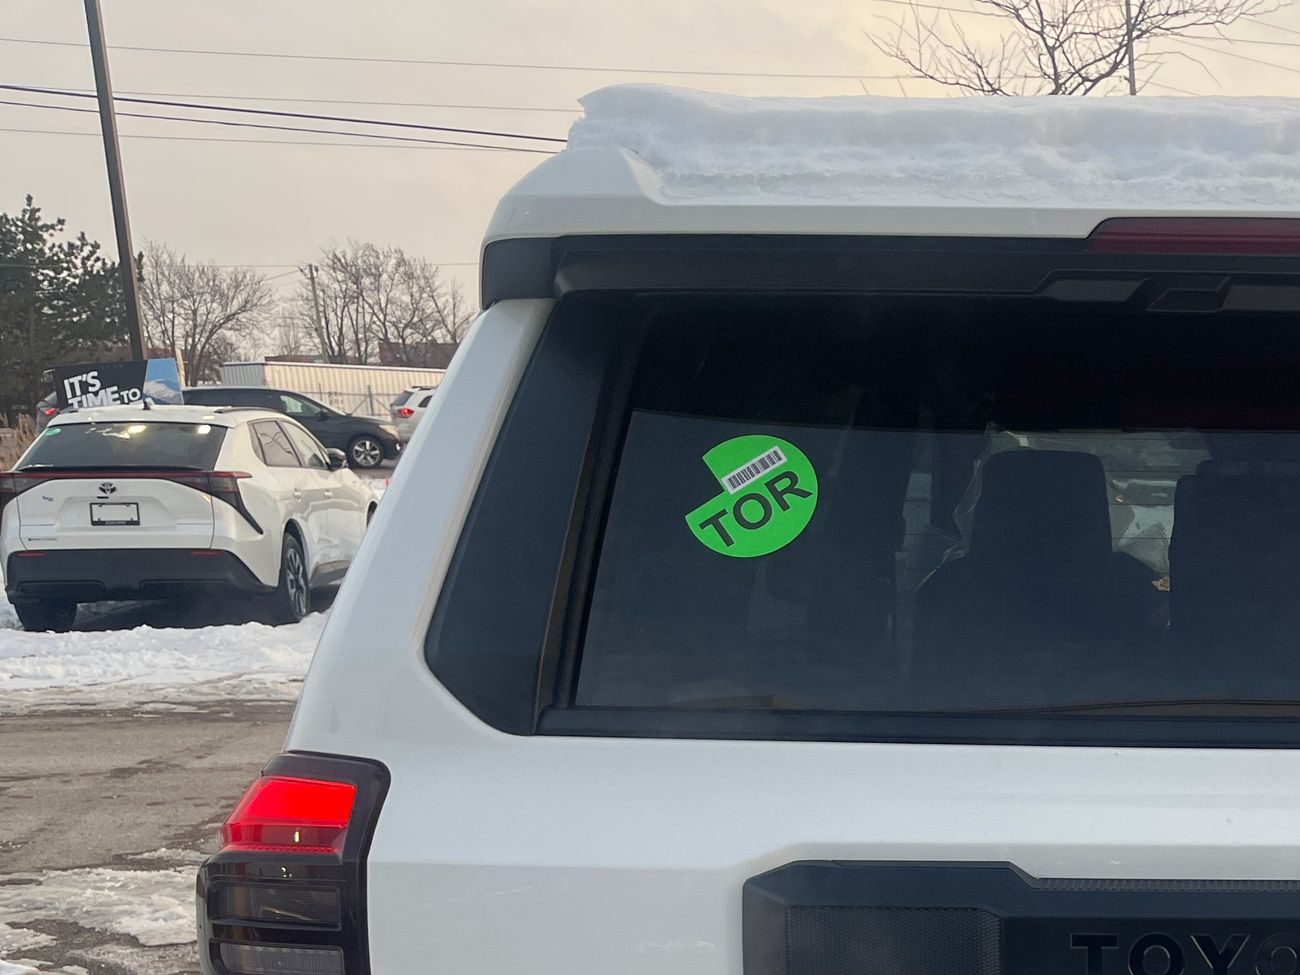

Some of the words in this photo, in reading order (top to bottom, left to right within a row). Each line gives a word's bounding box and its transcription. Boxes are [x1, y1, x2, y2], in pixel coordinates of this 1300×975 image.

[63, 371, 101, 399] IT'S
[68, 386, 120, 409] TIME
[120, 388, 141, 403] TO
[698, 470, 813, 548] TOR
